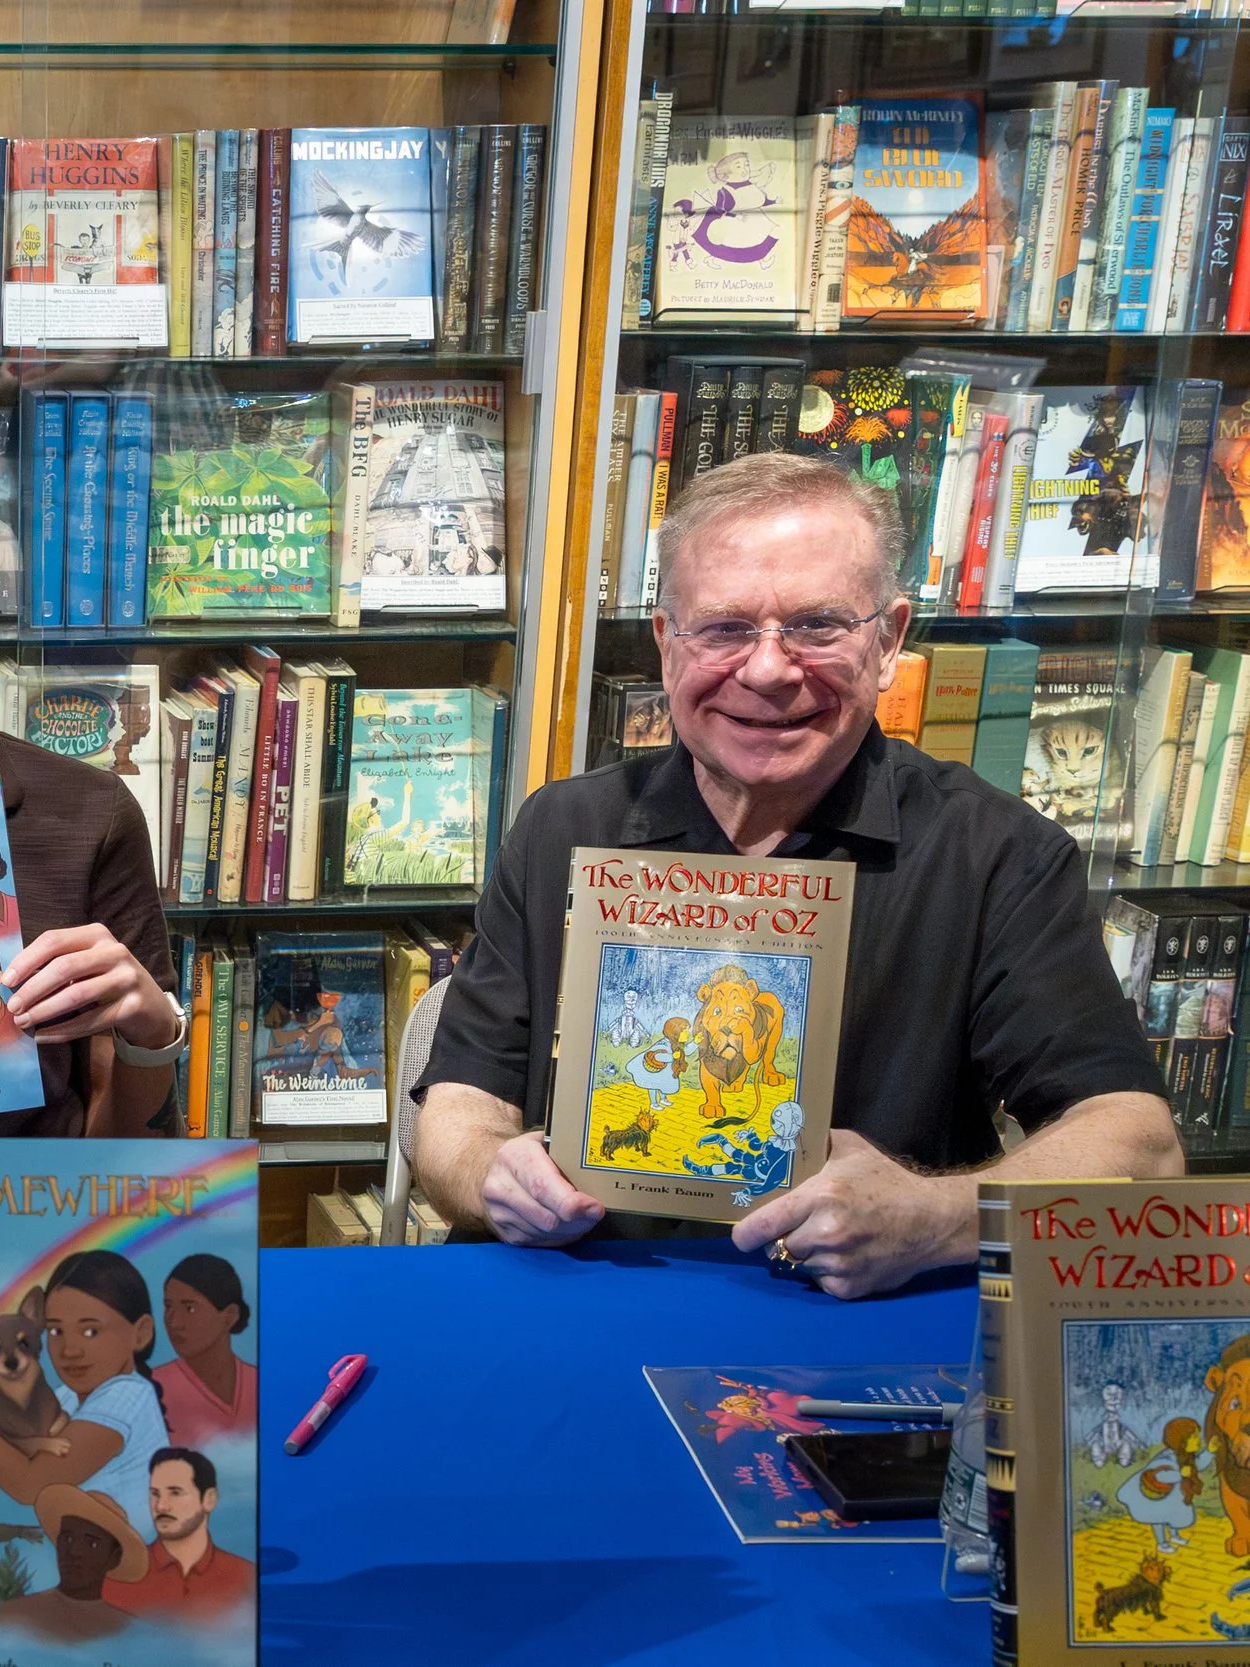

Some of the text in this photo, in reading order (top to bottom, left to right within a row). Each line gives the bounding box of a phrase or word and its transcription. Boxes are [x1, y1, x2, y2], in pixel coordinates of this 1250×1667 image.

[1146, 115, 1172, 126] NIMMO
[45, 143, 129, 161] HENRY
[290, 140, 424, 162] MOCKINGJAY
[1221, 142, 1247, 160] NIX
[30, 166, 140, 185] HUGGINS
[864, 170, 963, 189] SWORD
[1071, 148, 1091, 236] HOMER PRICE
[29, 201, 139, 213] by BEVERLY CLEARY
[646, 196, 657, 228] ANNE
[25, 231, 41, 241] BUS
[25, 242, 41, 251] STOP
[270, 189, 282, 293] CATCHING FIRE
[387, 402, 500, 423] WONDERFUL STORY OF
[387, 412, 475, 429] HENRY SUGAR
[351, 397, 371, 478] The BFG
[660, 407, 674, 459] PULLMAN
[657, 470, 667, 490] WAS
[1029, 479, 1100, 498] IGHTNING
[191, 495, 281, 506] ROALD DAHL
[654, 498, 664, 520] RAT!
[161, 504, 313, 543] the magic
[1004, 466, 1028, 561] LIGHTNING THIEF
[1025, 504, 1059, 522] HIEF
[977, 520, 986, 549] RISING
[981, 515, 993, 550] VESPERS
[213, 539, 315, 579] finger
[306, 687, 316, 707] THIS
[1048, 683, 1127, 694] TIMES SQUARE
[34, 694, 103, 720] CHARLIE
[41, 719, 98, 736] CHOCOLATE
[305, 708, 314, 730] STAR
[361, 714, 462, 726] Gone-
[31, 728, 104, 755] FACTORY
[304, 732, 313, 760] SHALL
[365, 731, 454, 747] Away
[365, 746, 454, 765] Lake
[302, 762, 311, 789] ABIDE
[361, 768, 455, 781] Elizabeth Enright
[256, 735, 272, 843] LITTLE BO IN FRANCE
[208, 754, 227, 861] The Great American Mousical
[273, 785, 290, 836] PET
[582, 859, 842, 902] The WONDERFUL
[597, 894, 820, 938] WIZARD of OZ
[263, 1074, 367, 1092] The Weirdstone
[614, 1181, 714, 1199] L. Frank Baum
[1020, 1197, 1096, 1240] The
[1048, 1244, 1237, 1291] WIZARD
